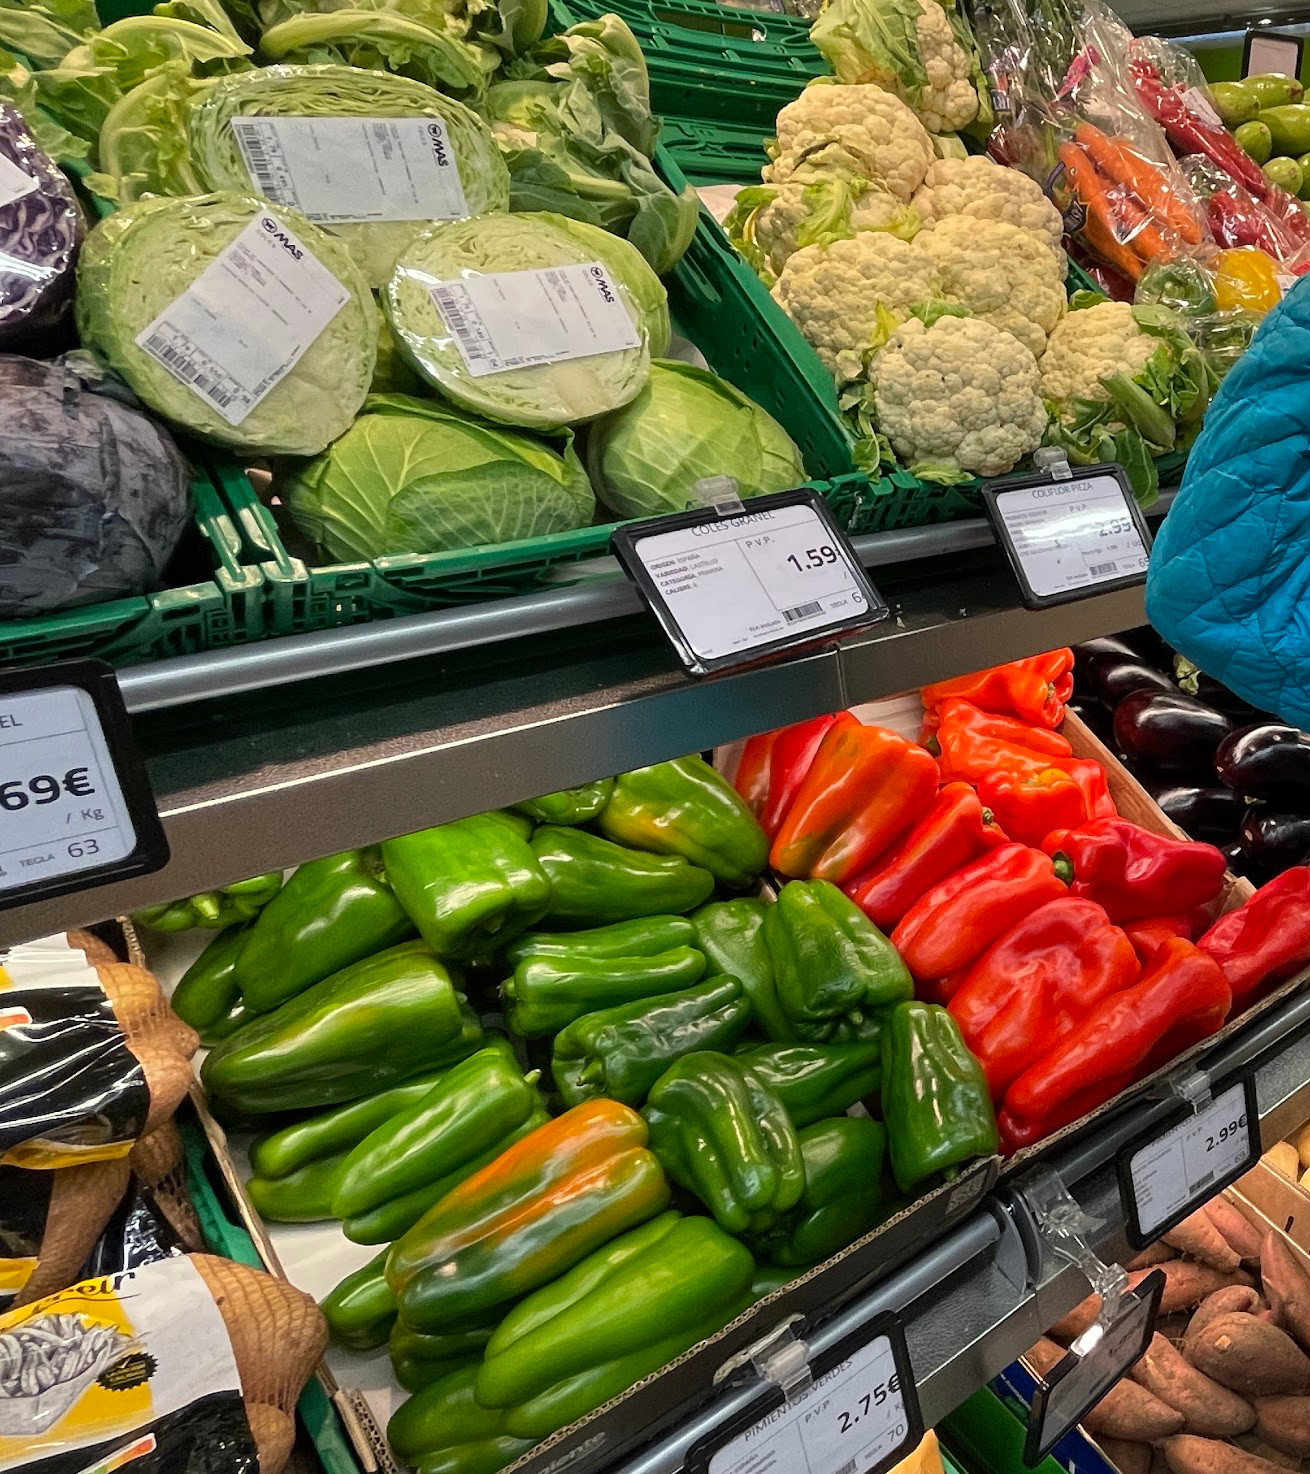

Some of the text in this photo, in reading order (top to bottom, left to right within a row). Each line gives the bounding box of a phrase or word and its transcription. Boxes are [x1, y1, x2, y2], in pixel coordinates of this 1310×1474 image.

[432, 137, 449, 168] MAS
[274, 232, 304, 261] MAS
[596, 277, 615, 304] MAS
[691, 511, 776, 538] COLES GRANEL
[0, 766, 96, 811] 69€
[81, 807, 105, 822] Kg
[20, 838, 100, 868] TECLA 63
[744, 1358, 853, 1442] PIMIENTOS VERDES
[837, 1371, 900, 1435] 2.75€
[887, 1423, 905, 1443] 70
